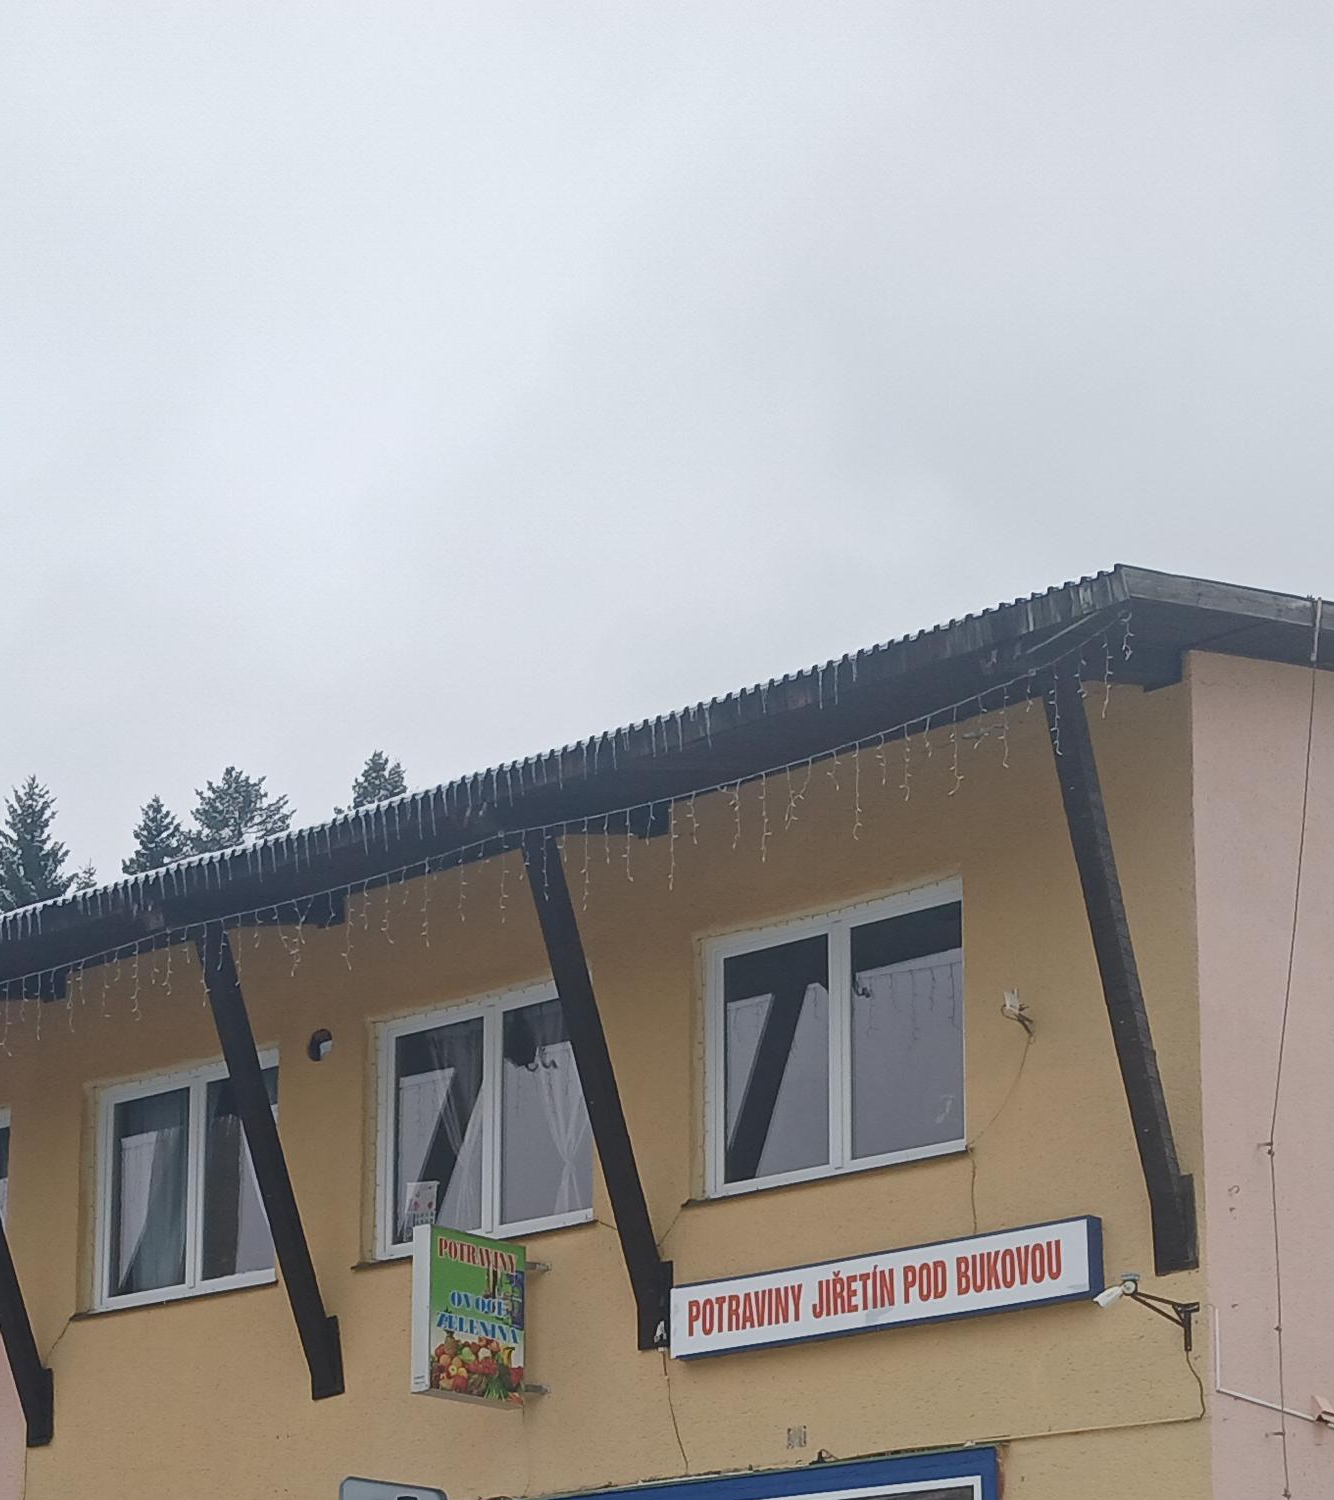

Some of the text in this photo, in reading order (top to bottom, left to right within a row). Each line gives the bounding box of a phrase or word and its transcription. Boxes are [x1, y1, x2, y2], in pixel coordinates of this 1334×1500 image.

[438, 1237, 517, 1274] POTRAVINY
[450, 1291, 509, 1317] OVOCE
[687, 1239, 1062, 1337] POTRAVINY JIŘETÍN POD BUKOVOU
